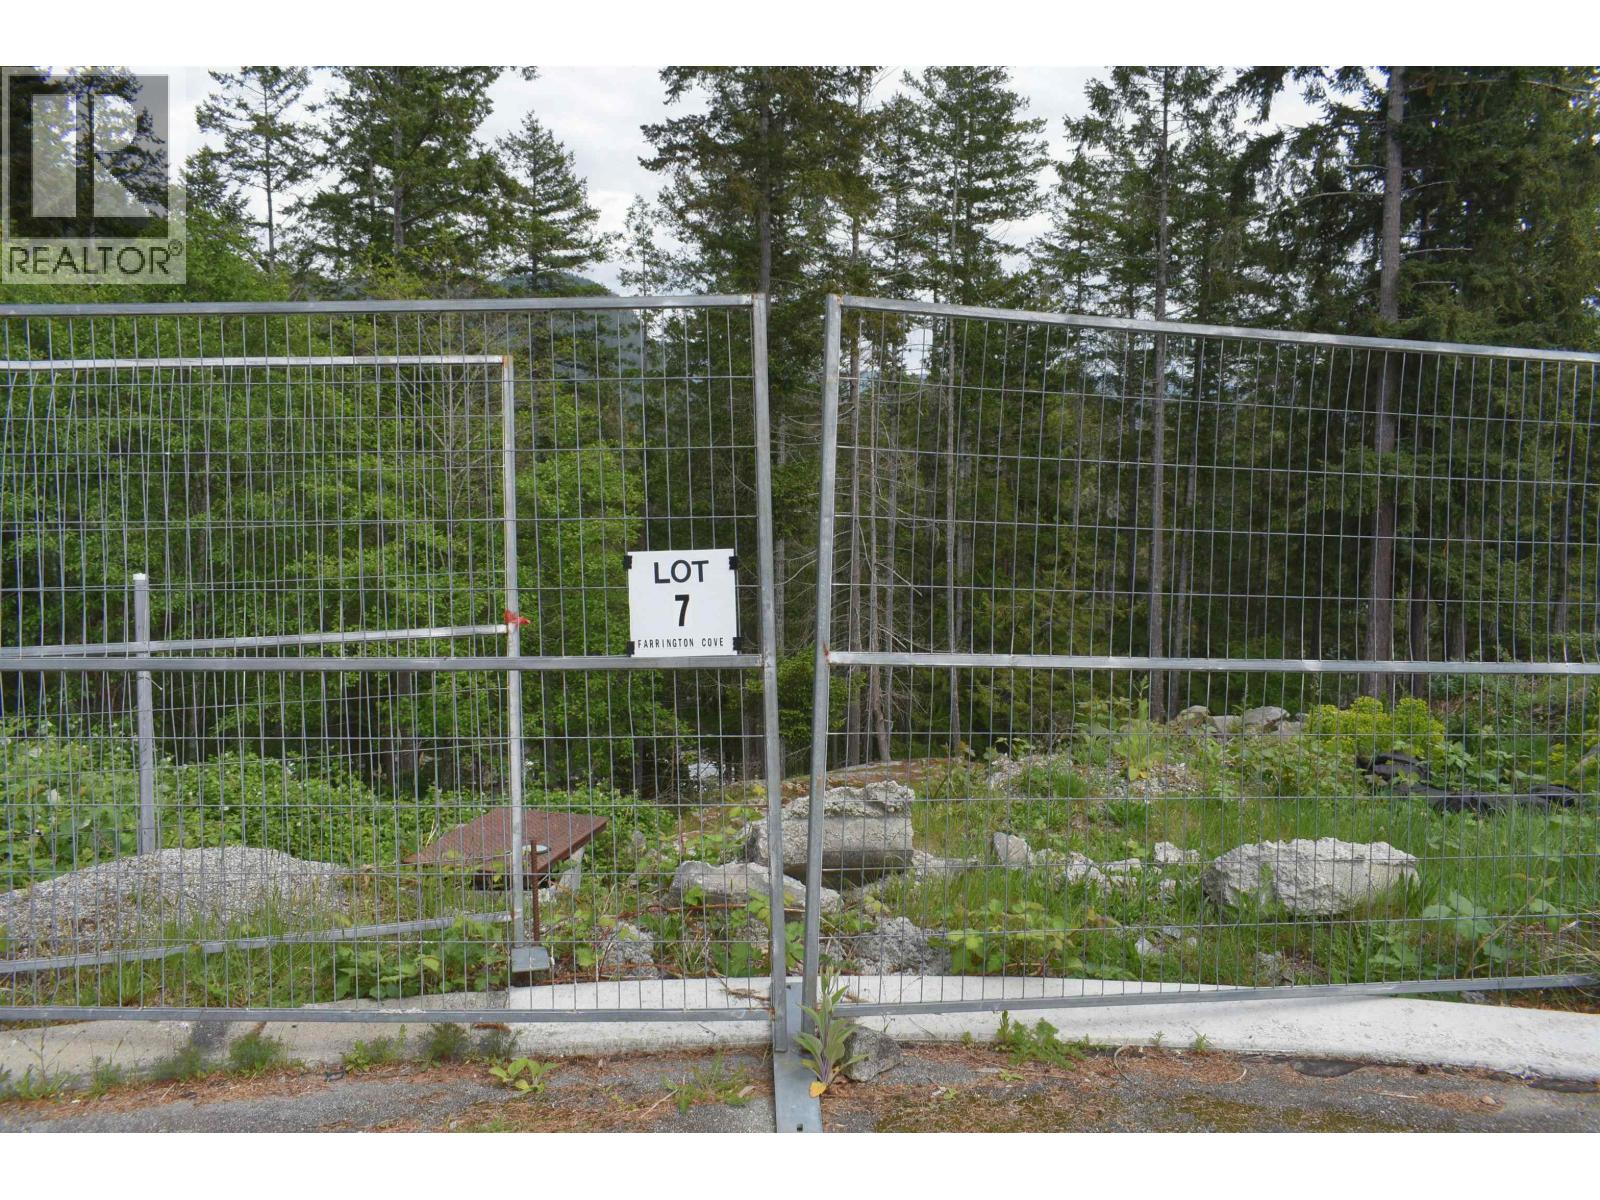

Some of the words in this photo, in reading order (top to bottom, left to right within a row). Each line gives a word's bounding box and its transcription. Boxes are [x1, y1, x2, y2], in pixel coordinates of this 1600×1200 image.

[653, 559, 709, 584] LOT
[674, 594, 690, 627] 7
[637, 637, 694, 649] FARRINGTON
[701, 637, 724, 648] COVE
